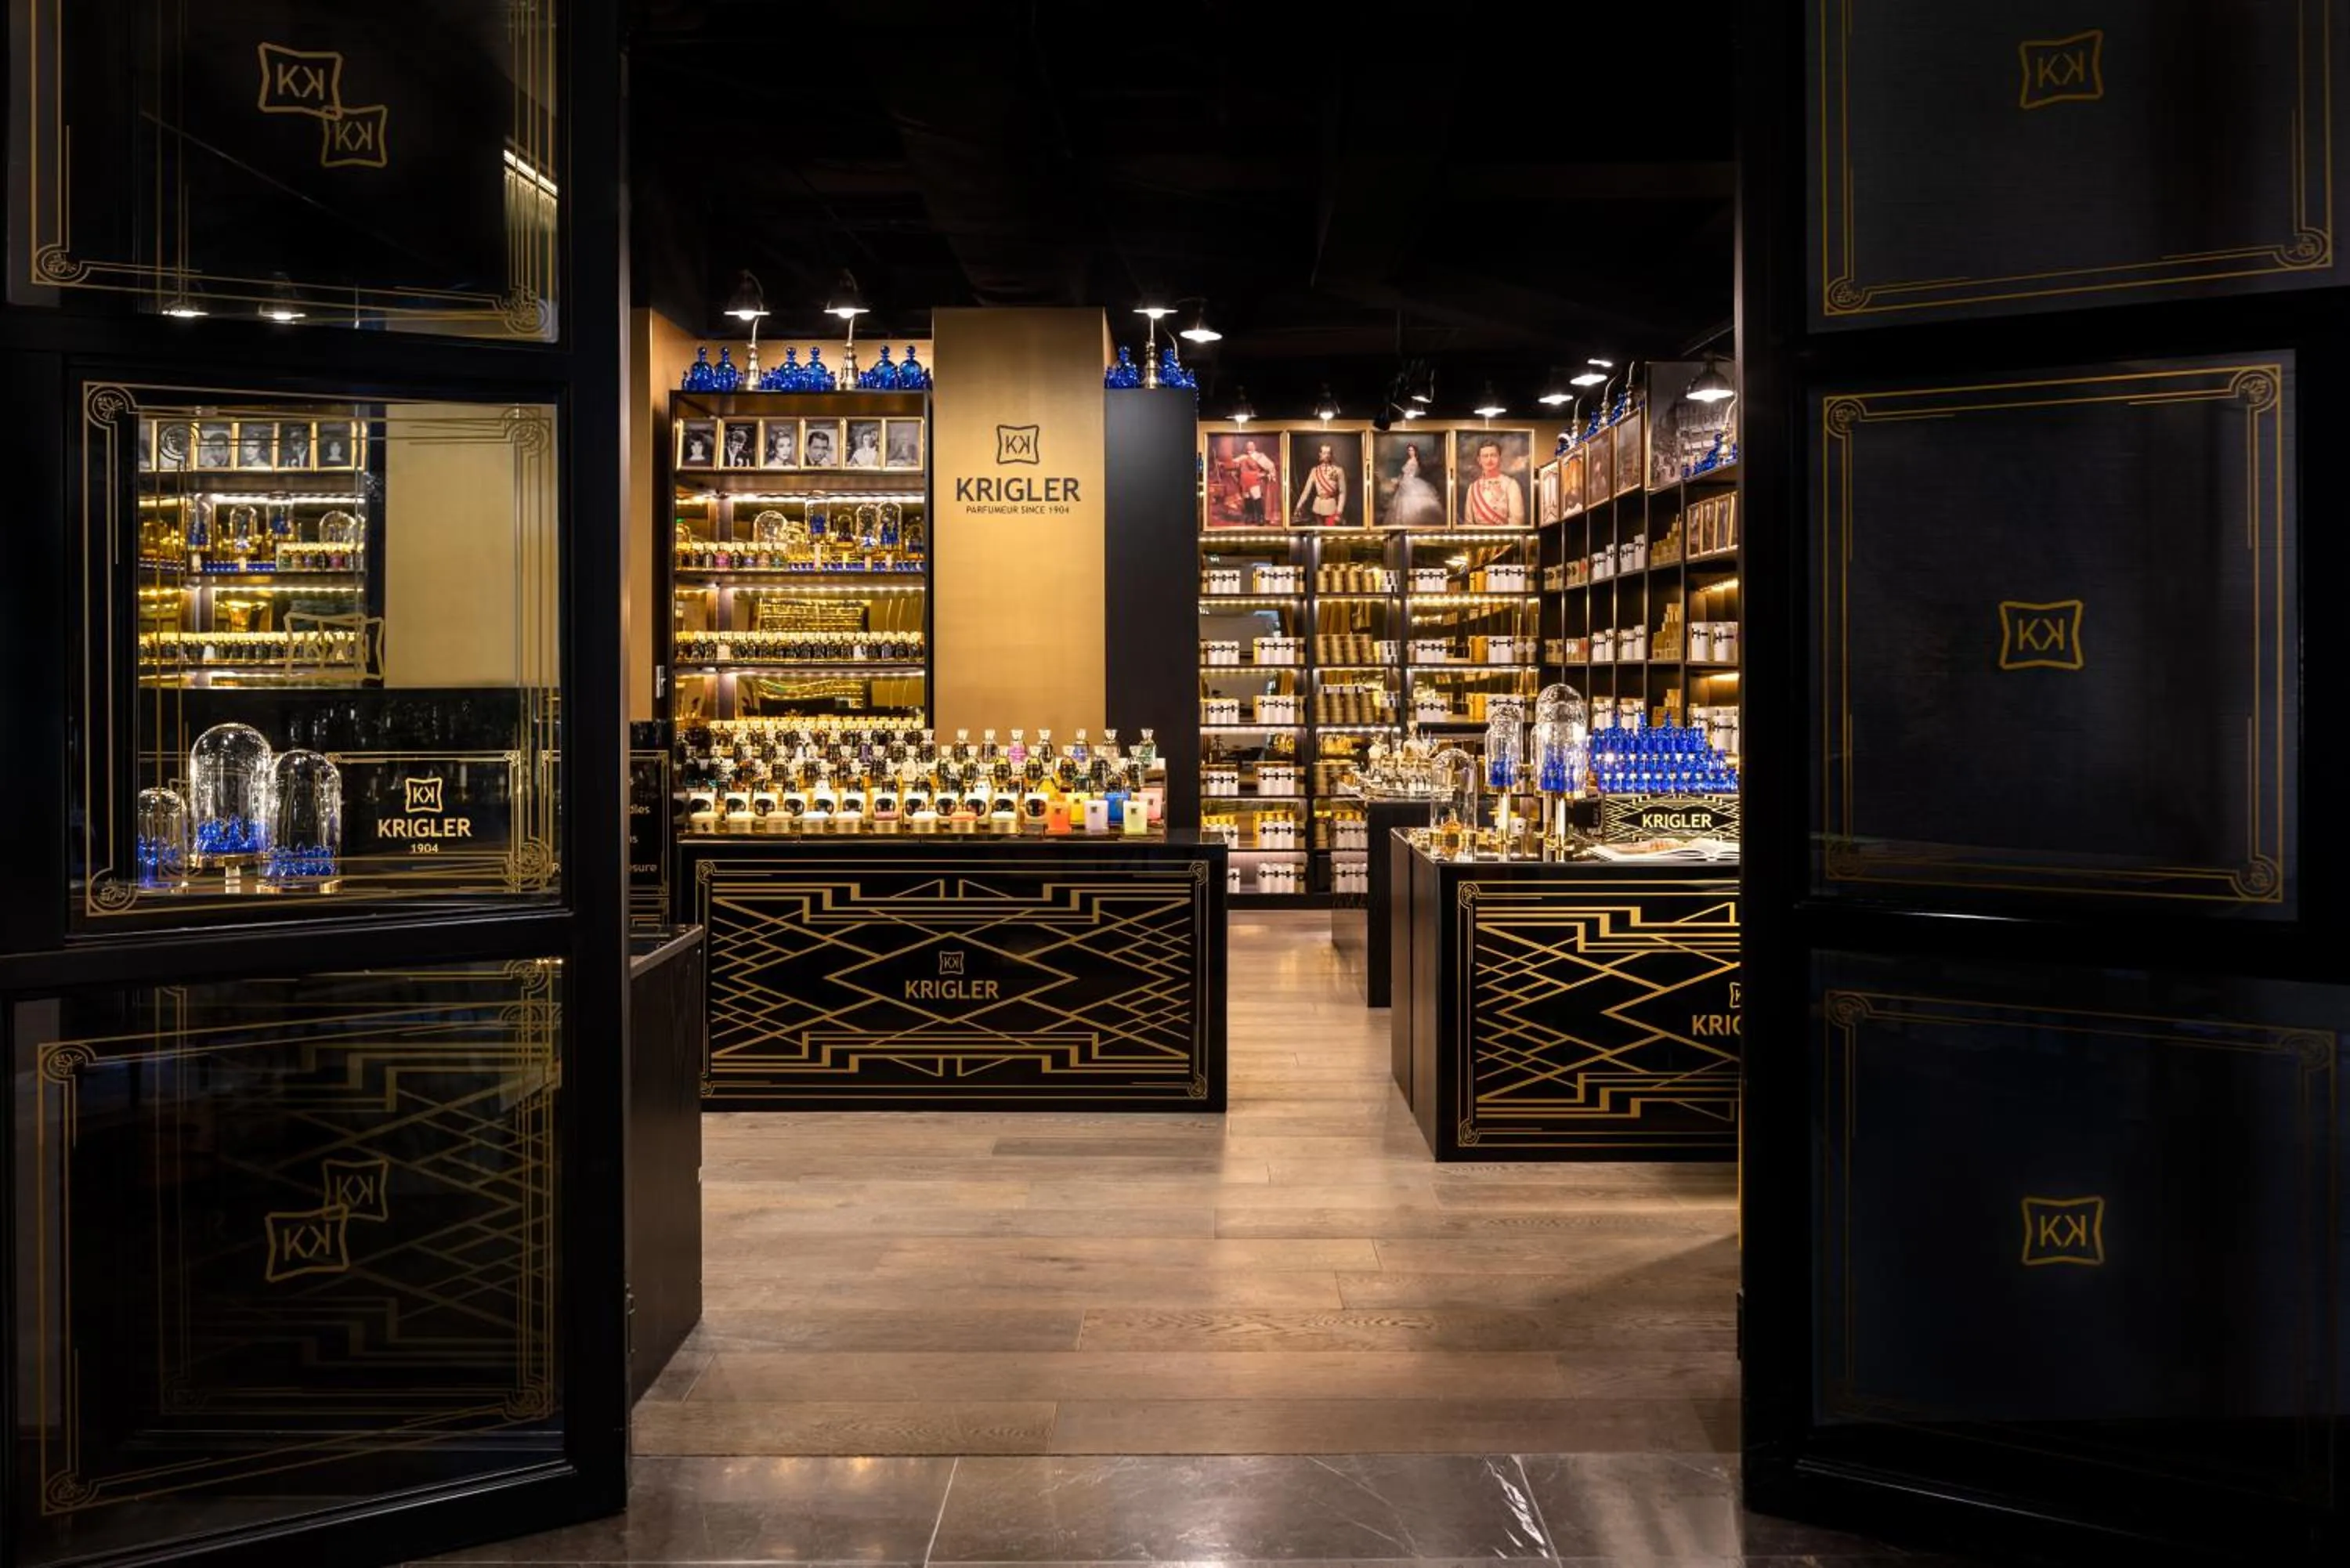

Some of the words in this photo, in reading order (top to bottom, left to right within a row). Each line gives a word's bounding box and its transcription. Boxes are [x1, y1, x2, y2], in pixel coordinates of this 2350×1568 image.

[956, 477, 1081, 502] KRIGLER
[966, 505, 1018, 515] PARFUMEUR
[1021, 505, 1045, 515] SINCE
[1049, 505, 1069, 515] 1904
[378, 818, 472, 838] KRIGLER
[1642, 813, 1712, 828] KRIGLER
[410, 843, 439, 853] 1904
[906, 980, 1000, 999] KRIGLER
